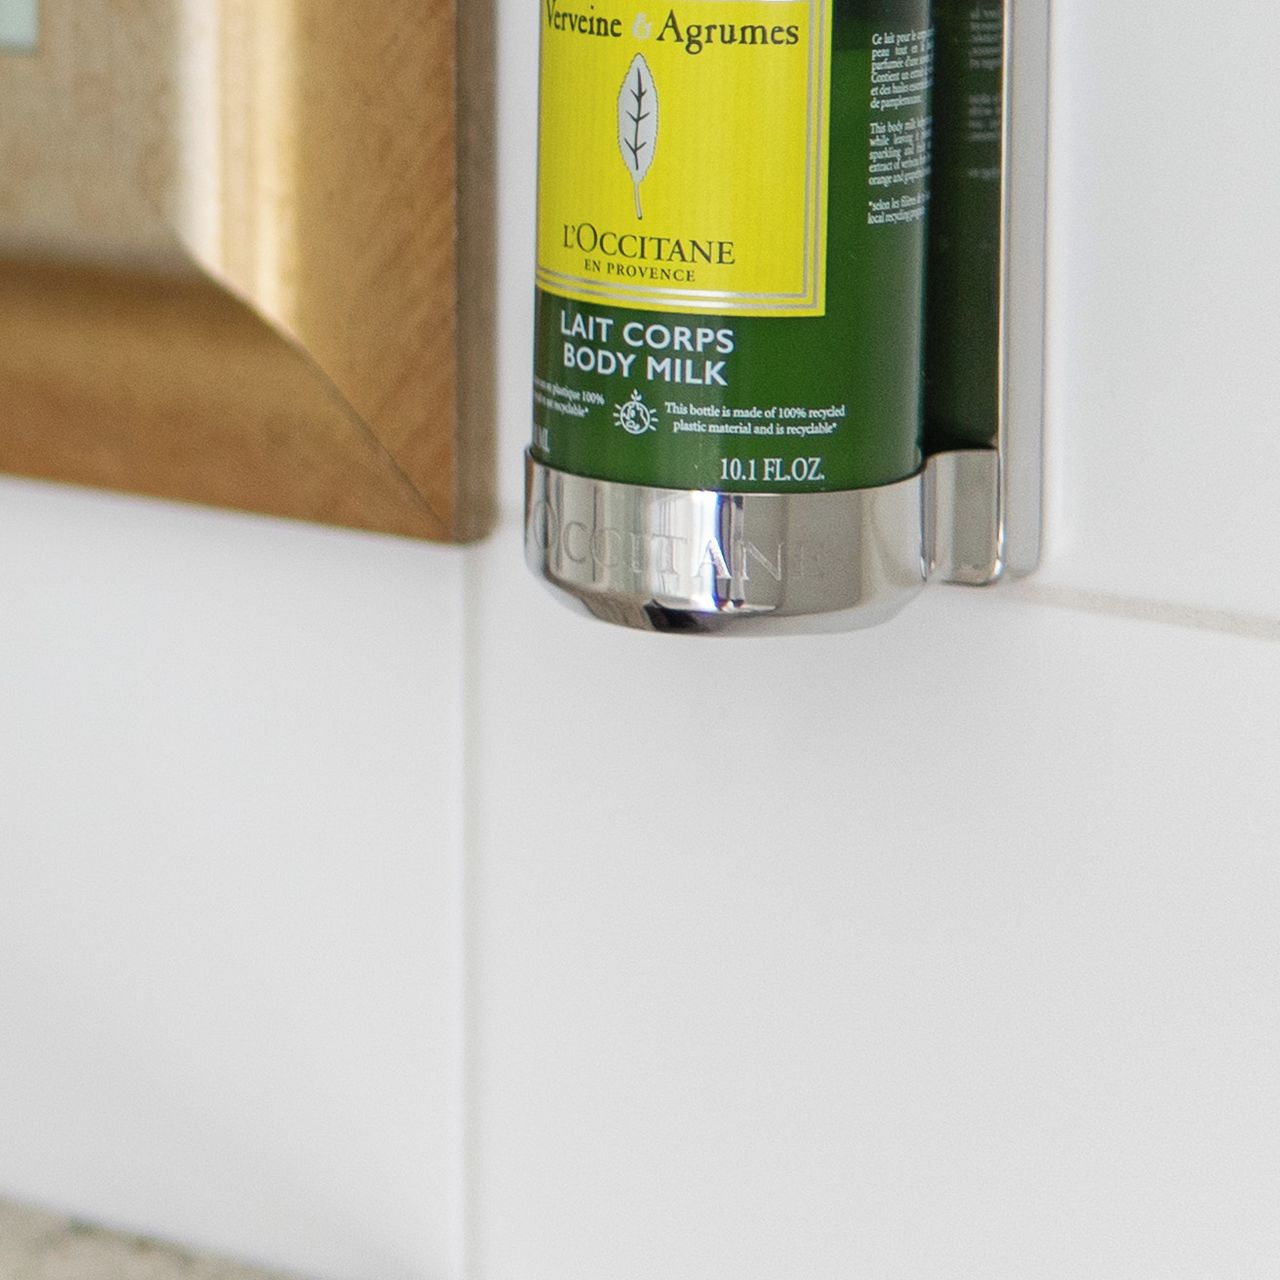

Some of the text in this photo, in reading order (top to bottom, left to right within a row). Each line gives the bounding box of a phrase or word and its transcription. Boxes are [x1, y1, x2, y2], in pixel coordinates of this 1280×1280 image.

[632, 12, 652, 40] &
[656, 9, 800, 55] Agrumes
[869, 122, 886, 134] This
[584, 259, 695, 282] EN PROVENCE
[560, 310, 734, 354] LAIT CORPS
[563, 341, 728, 386] BODY MILK
[582, 391, 605, 405] 100%
[664, 401, 846, 421] This bottle is made of 100% recycled
[673, 419, 707, 433] plastic
[708, 421, 752, 434] material
[753, 423, 774, 435] and
[775, 423, 785, 435] is
[720, 457, 825, 481] 10.1 FL.OZ.
